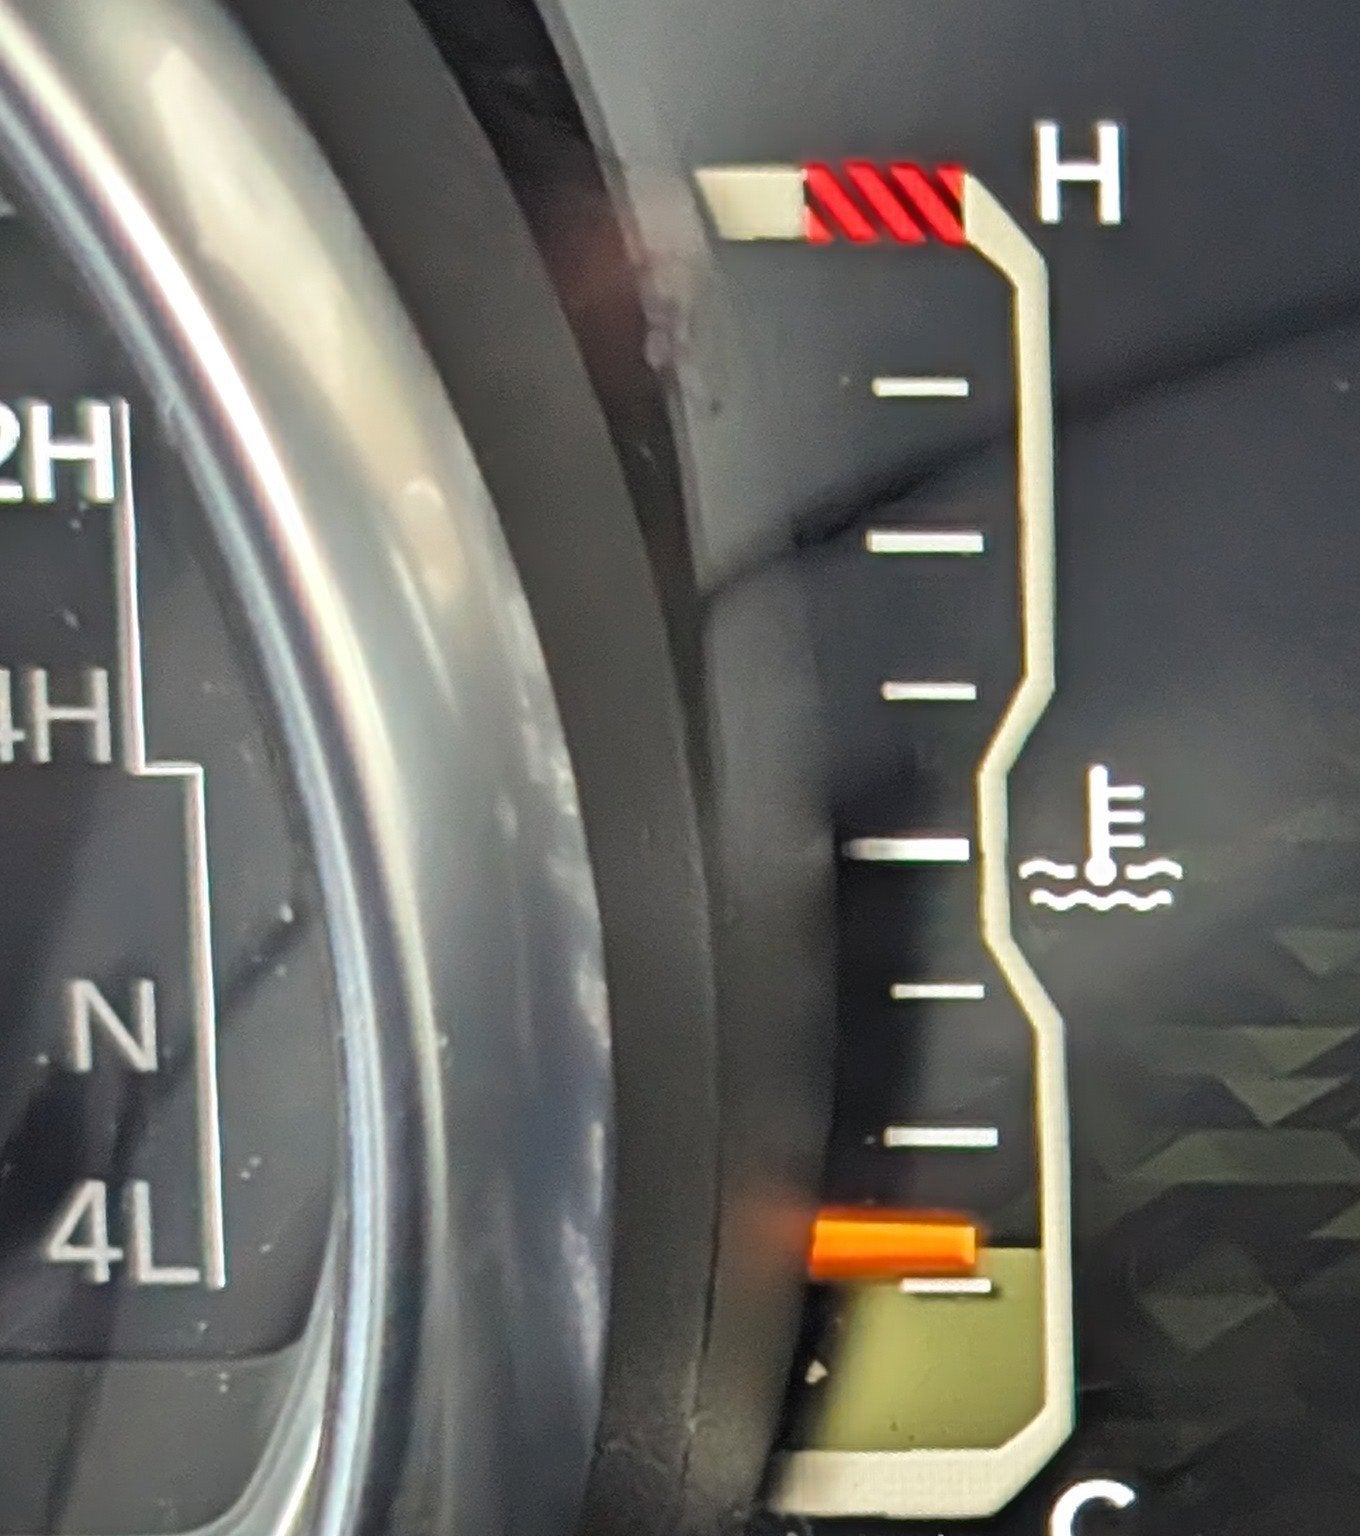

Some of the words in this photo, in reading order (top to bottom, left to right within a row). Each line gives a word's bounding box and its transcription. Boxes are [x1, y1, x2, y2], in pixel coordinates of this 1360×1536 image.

[1036, 121, 1120, 225] H
[62, 976, 159, 1073] N
[44, 1179, 201, 1286] 4L
